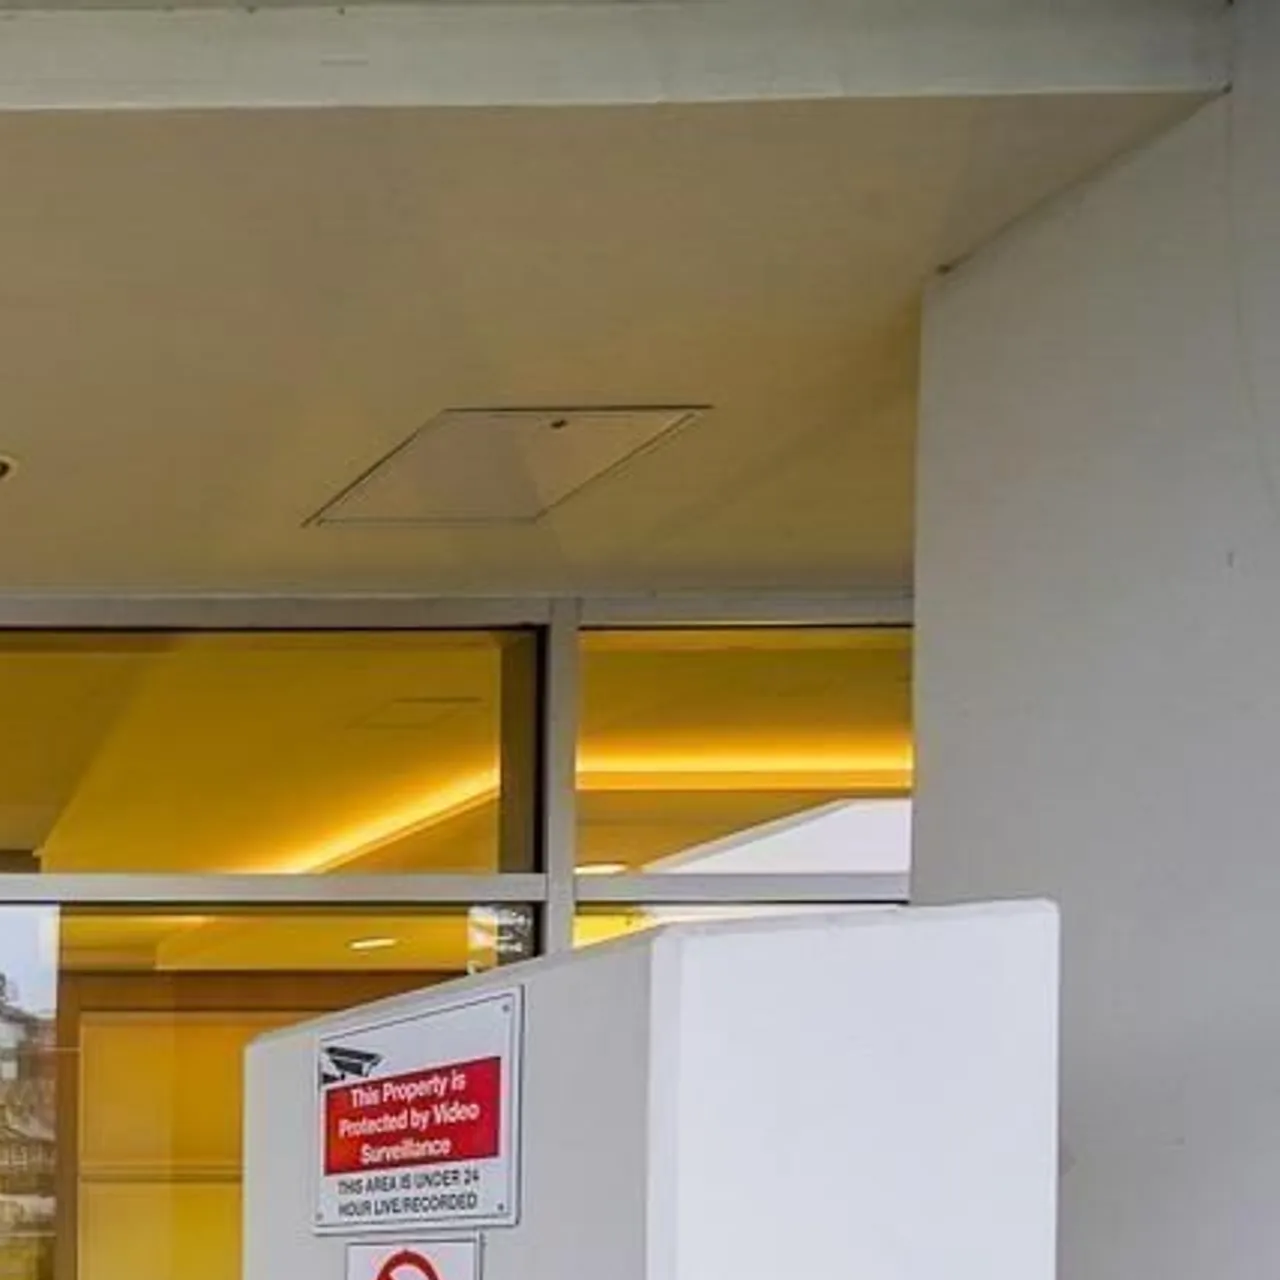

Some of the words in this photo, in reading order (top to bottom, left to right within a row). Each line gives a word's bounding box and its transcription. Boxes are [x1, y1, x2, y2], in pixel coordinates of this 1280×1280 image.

[351, 1088, 379, 1107] This
[383, 1073, 448, 1104] Property
[451, 1069, 466, 1091] is
[339, 1111, 408, 1138] Protected
[410, 1109, 430, 1132] by
[432, 1101, 480, 1124] Video
[361, 1137, 452, 1164] Surveillance
[338, 1179, 363, 1195] THIS
[365, 1175, 397, 1193] AREA
[400, 1173, 411, 1189] IS
[413, 1169, 460, 1189] UNDER
[463, 1167, 480, 1185] 24
[338, 1200, 372, 1217] HOUR
